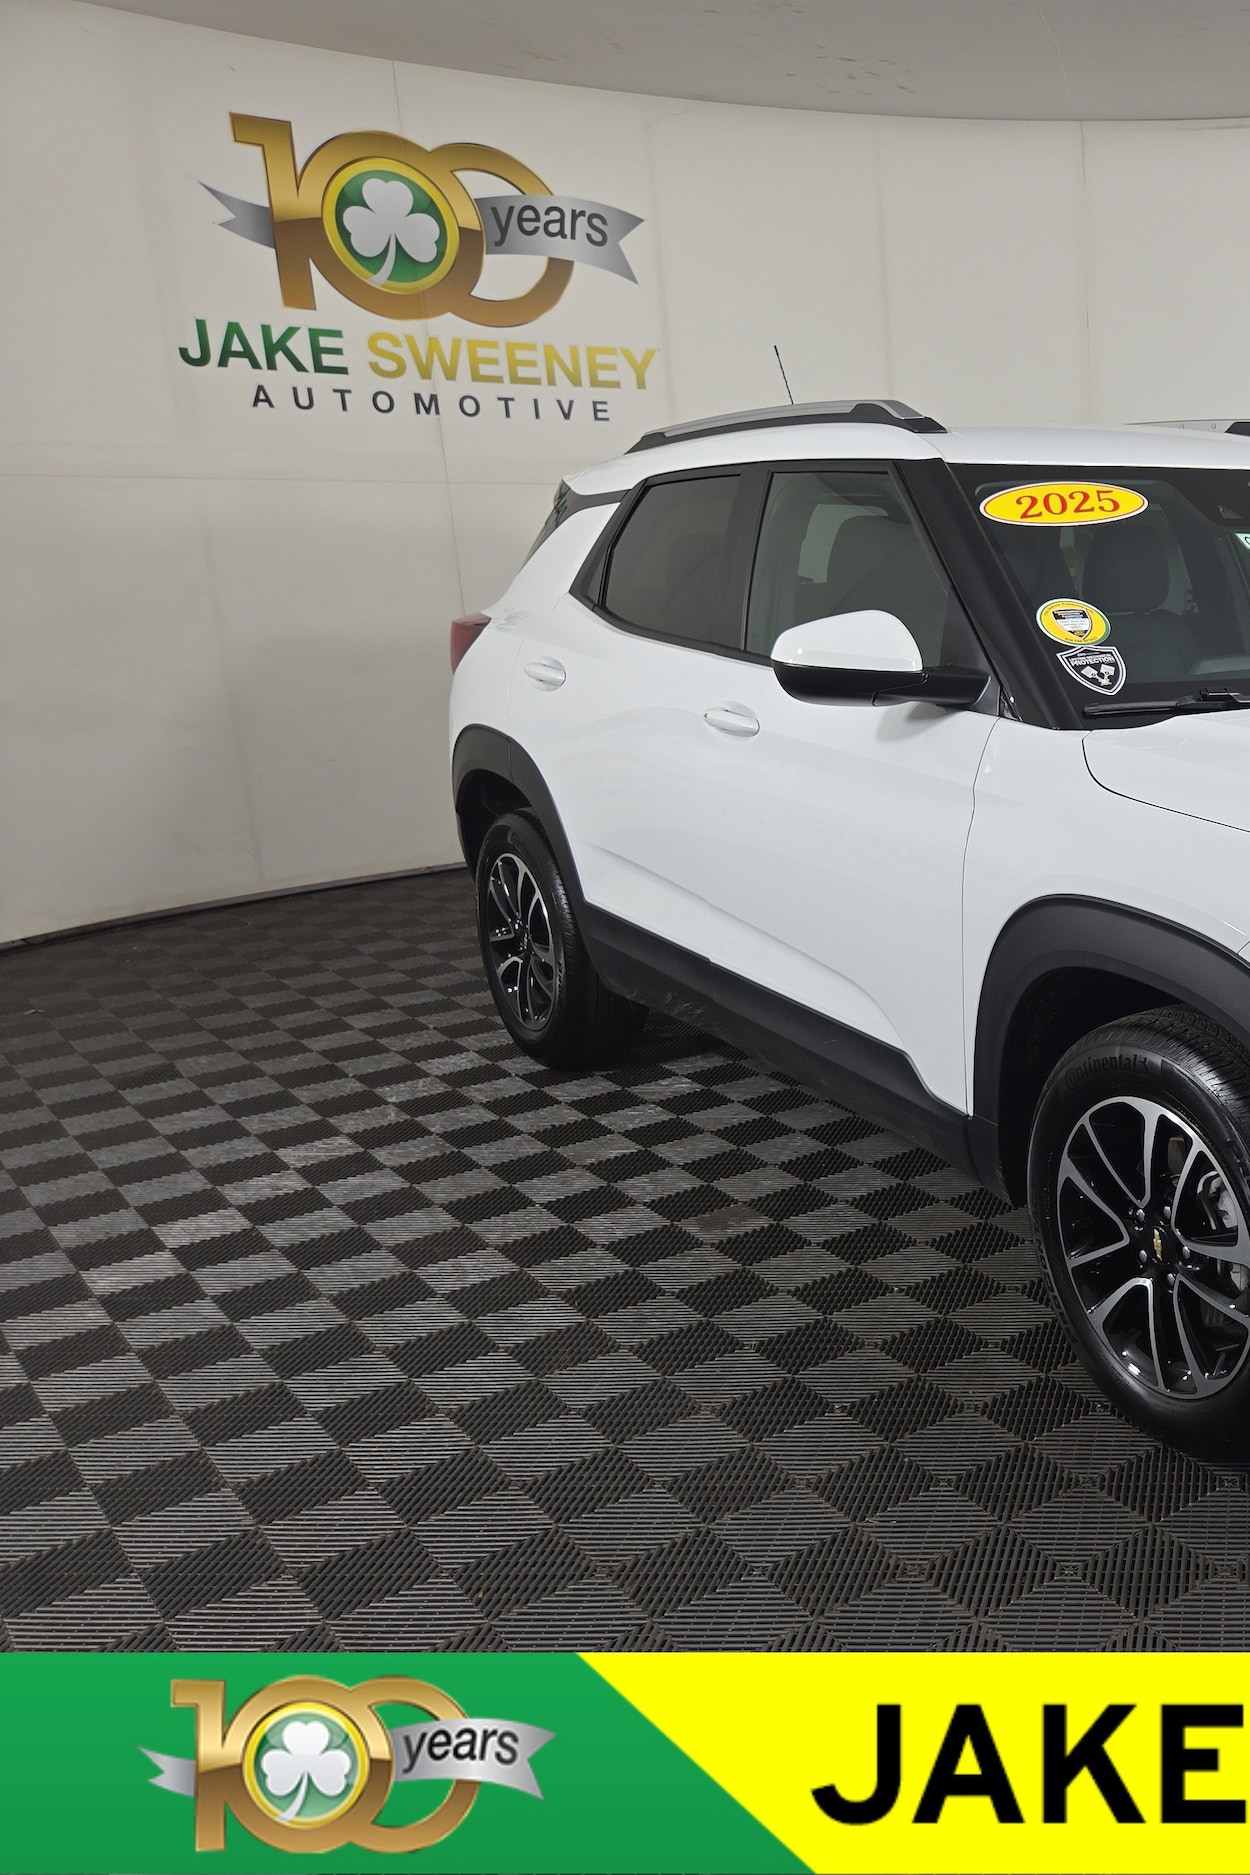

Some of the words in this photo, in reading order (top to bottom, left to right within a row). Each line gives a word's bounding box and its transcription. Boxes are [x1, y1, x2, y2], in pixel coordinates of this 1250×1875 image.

[228, 111, 575, 328] 100
[489, 202, 609, 248] years
[178, 318, 350, 376] JAKE
[366, 330, 658, 391] SWEENEY
[251, 383, 611, 422] AUTOMOTIVE
[1015, 489, 1121, 520] 2025
[1066, 1053, 1138, 1090] Continental
